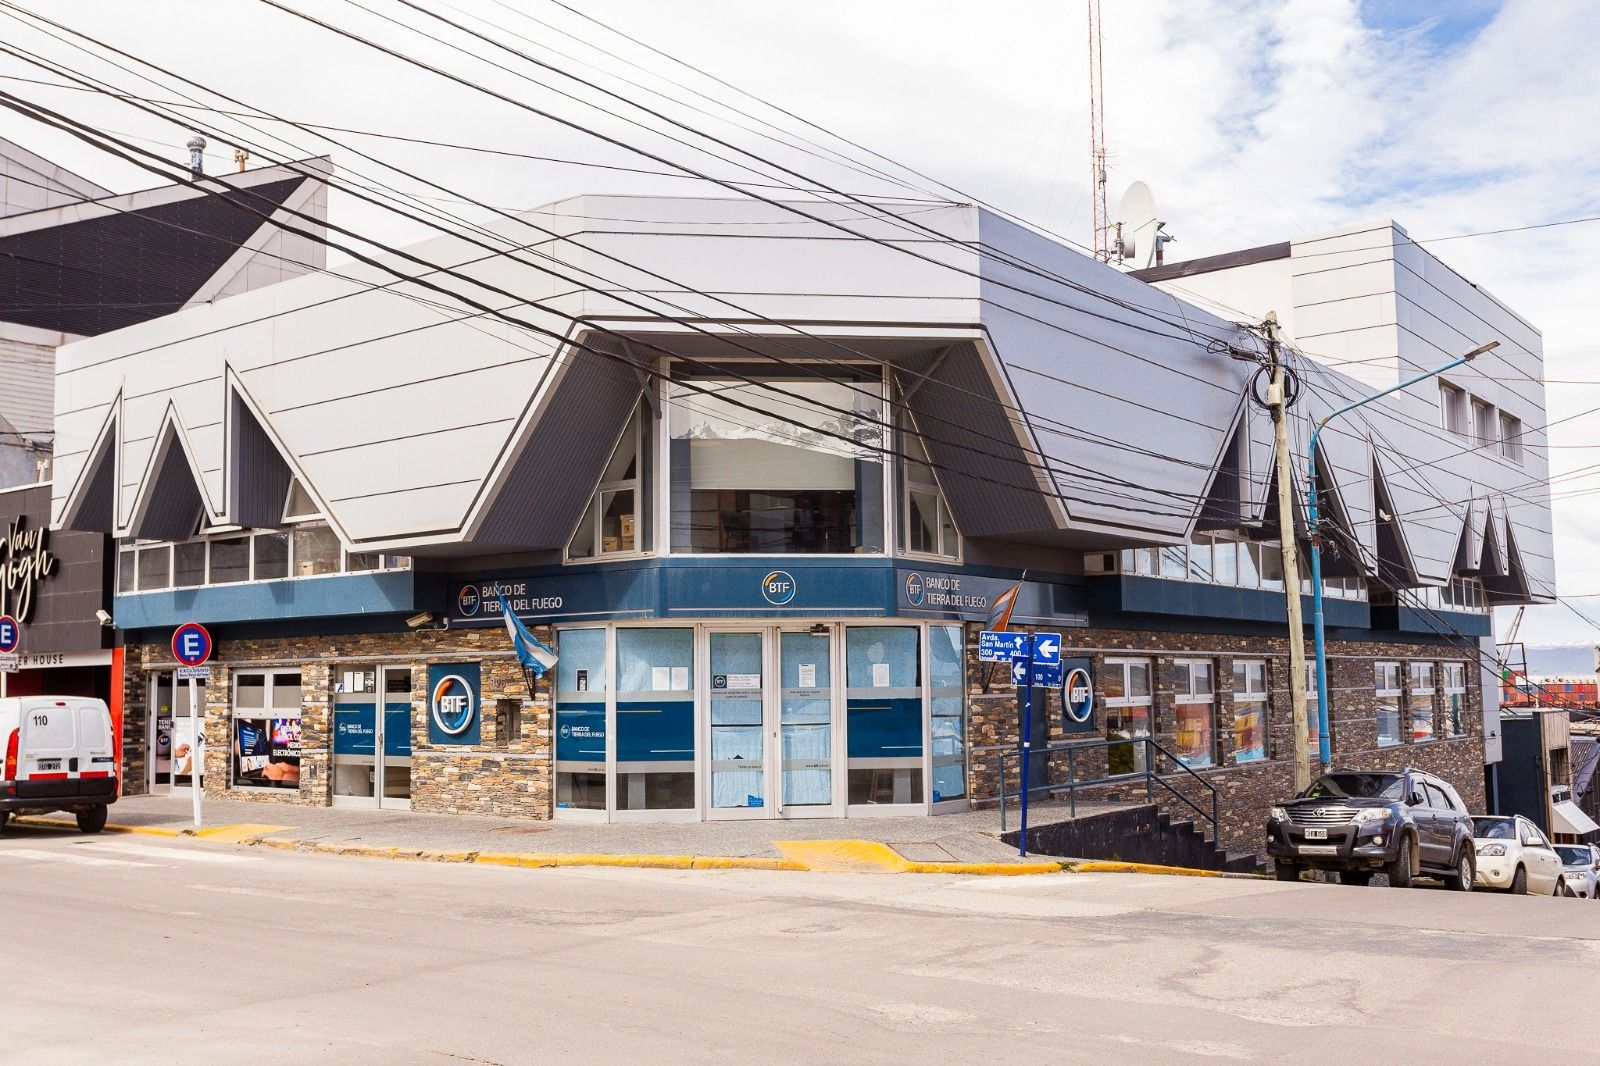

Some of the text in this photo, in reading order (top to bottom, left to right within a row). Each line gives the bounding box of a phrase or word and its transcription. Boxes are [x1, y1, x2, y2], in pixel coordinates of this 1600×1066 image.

[8, 514, 37, 558] Van
[482, 583, 526, 597] BANCO DE
[769, 582, 790, 593] BTF
[909, 584, 922, 594] BTF
[925, 577, 961, 591] BANCO DE
[463, 595, 476, 606] BTF
[482, 596, 563, 612] TIERA DEL FUEGO
[926, 592, 987, 608] TIERRA DEL FUEGO
[1, 624, 12, 644] E
[981, 633, 1000, 641] Avda.
[184, 634, 200, 656] E
[981, 640, 1014, 649] San Martín
[18, 656, 28, 666] ER
[32, 654, 64, 665] HOUSE
[1071, 686, 1089, 703] BTF
[441, 695, 467, 713] BTF
[33, 715, 48, 726] 110
